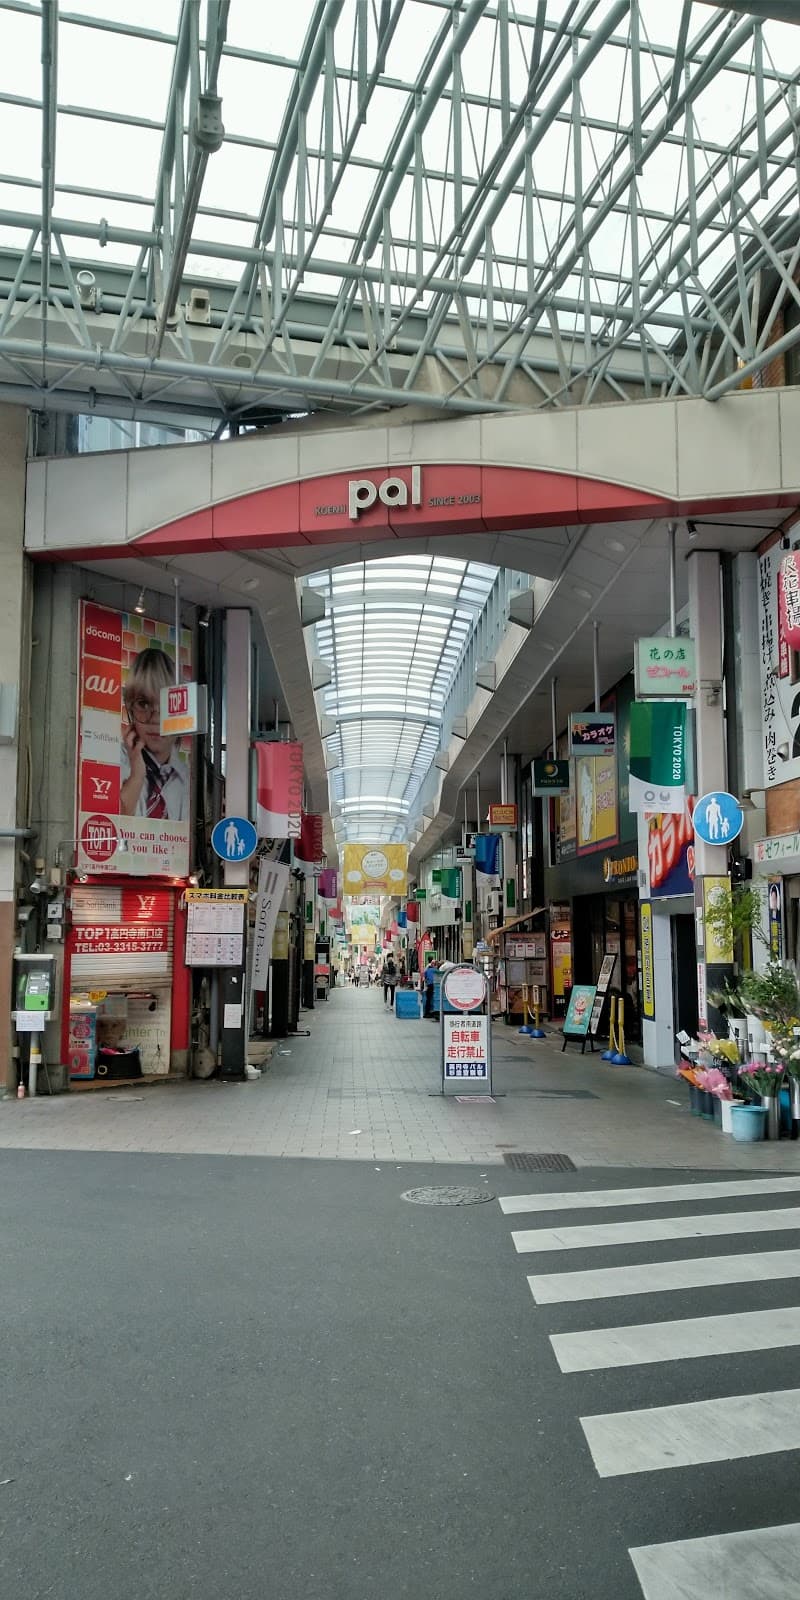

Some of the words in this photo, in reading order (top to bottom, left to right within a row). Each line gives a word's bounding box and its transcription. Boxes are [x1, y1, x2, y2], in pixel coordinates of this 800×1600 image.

[348, 465, 422, 521] pal
[428, 496, 456, 508] SINCE
[457, 494, 481, 506] 2003
[86, 626, 121, 643] docomo
[649, 648, 686, 660] 花の店
[85, 675, 119, 695] au
[673, 724, 683, 756] TOKYO
[288, 743, 303, 796] TOKYO
[672, 756, 682, 780] 2020
[140, 831, 155, 841] can
[160, 833, 188, 843] choose
[132, 844, 148, 855] you
[153, 844, 169, 855] like
[74, 941, 164, 953] TEL:03-3315-3777
[451, 1030, 480, 1043] 自転車
[447, 1045, 485, 1059] 走行禁止
